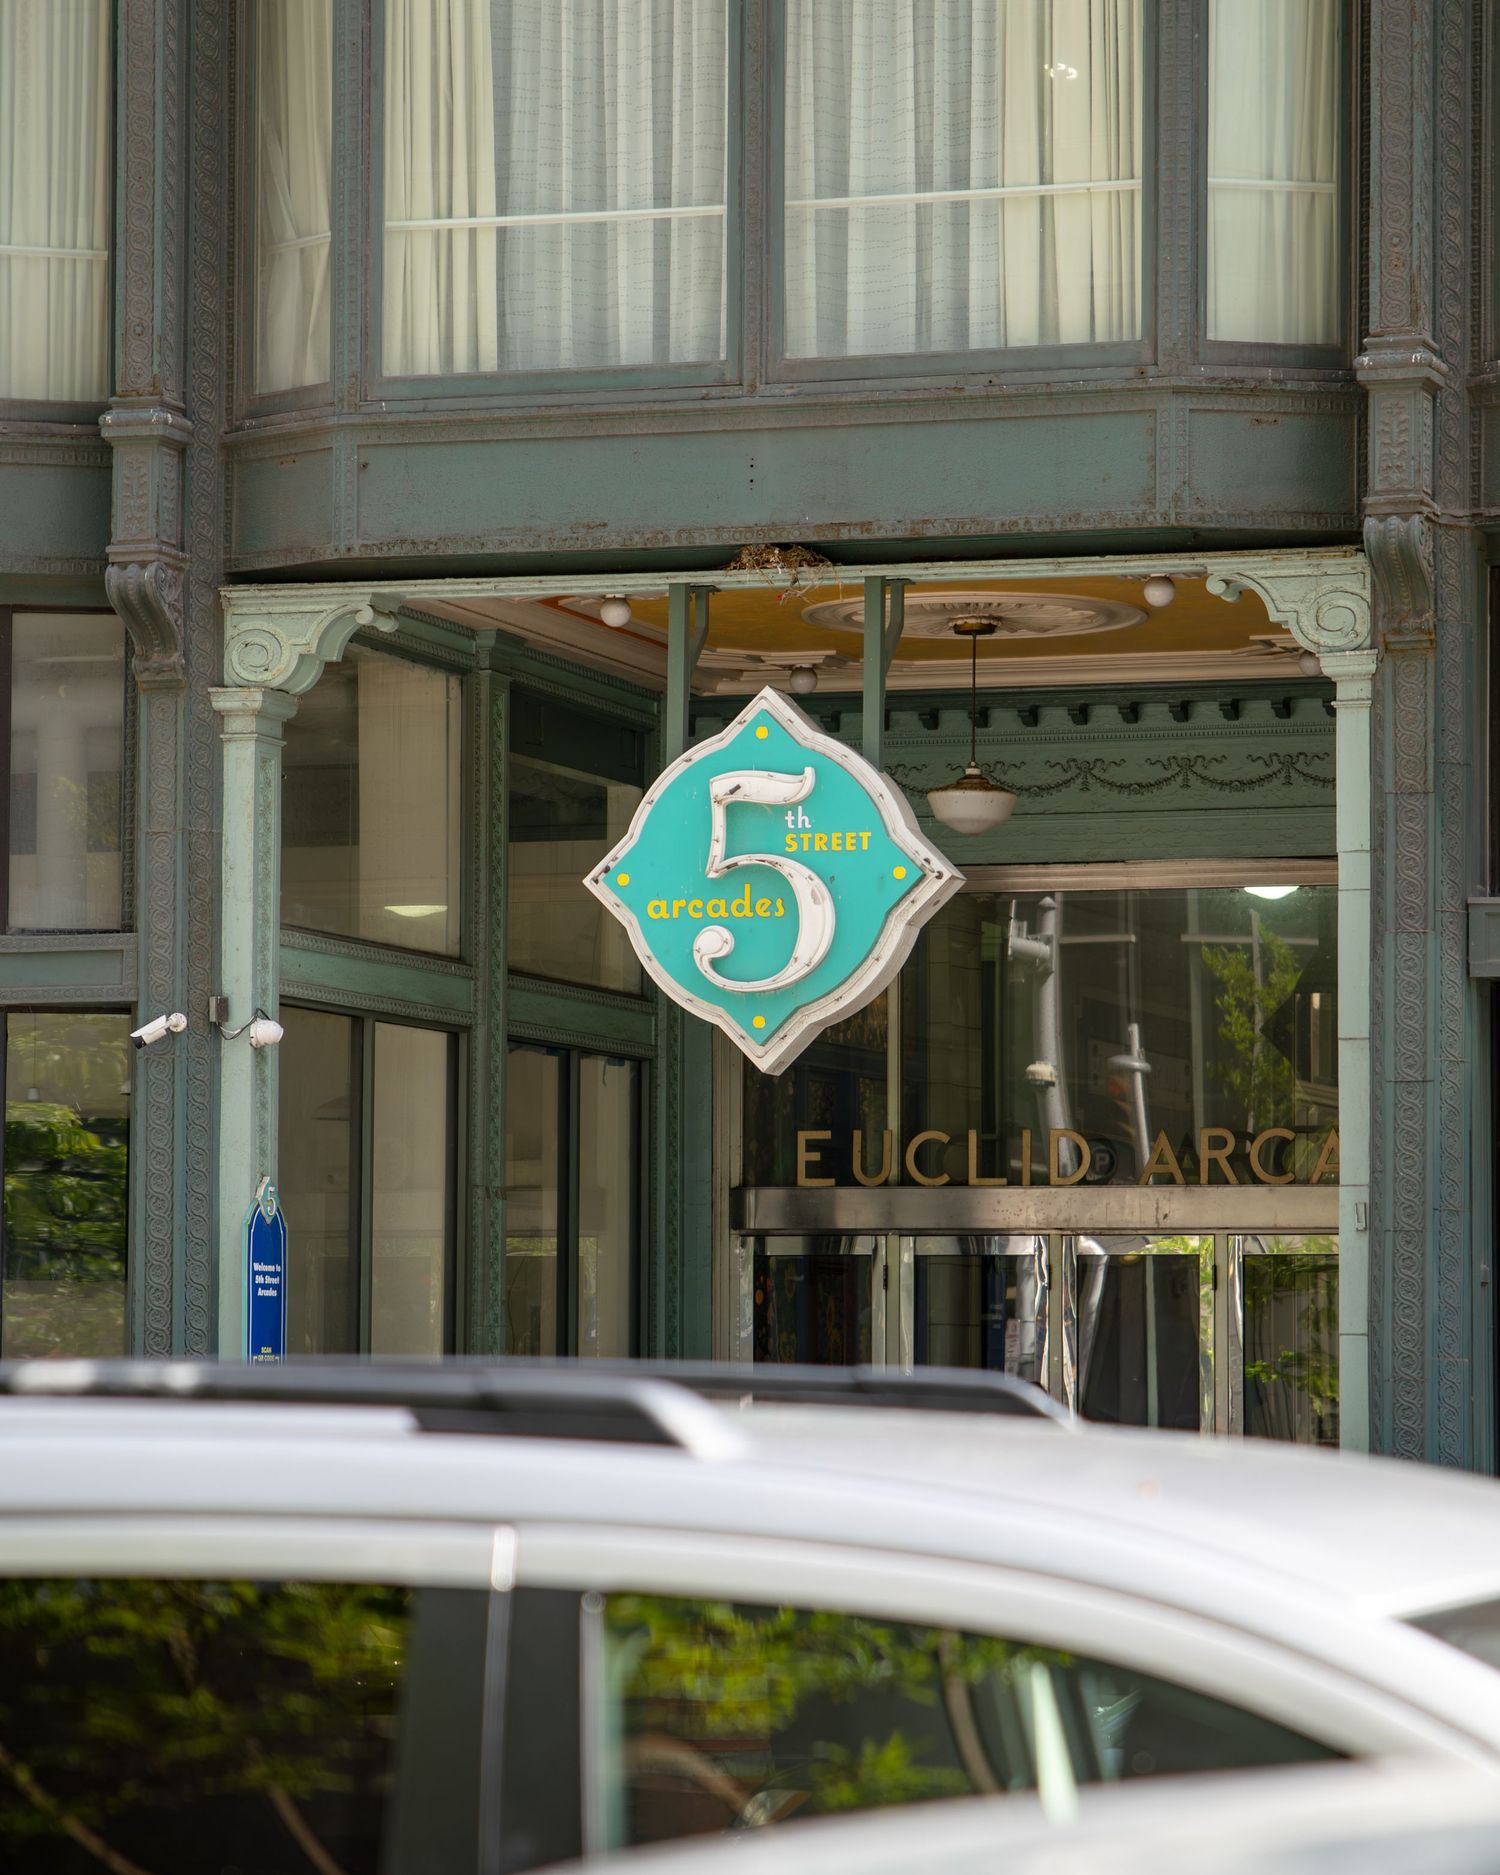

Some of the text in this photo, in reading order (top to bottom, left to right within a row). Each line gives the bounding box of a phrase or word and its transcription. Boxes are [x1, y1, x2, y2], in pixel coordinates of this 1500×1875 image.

[785, 832, 871, 852] STREET
[692, 766, 835, 992] 5 th
[646, 883, 785, 919] arcades
[797, 1128, 1092, 1187] EUCLID
[267, 1186, 276, 1216] 5
[253, 1262, 281, 1272] Welcome to
[255, 1274, 280, 1284] 5th Street
[257, 1287, 277, 1297] Arcades
